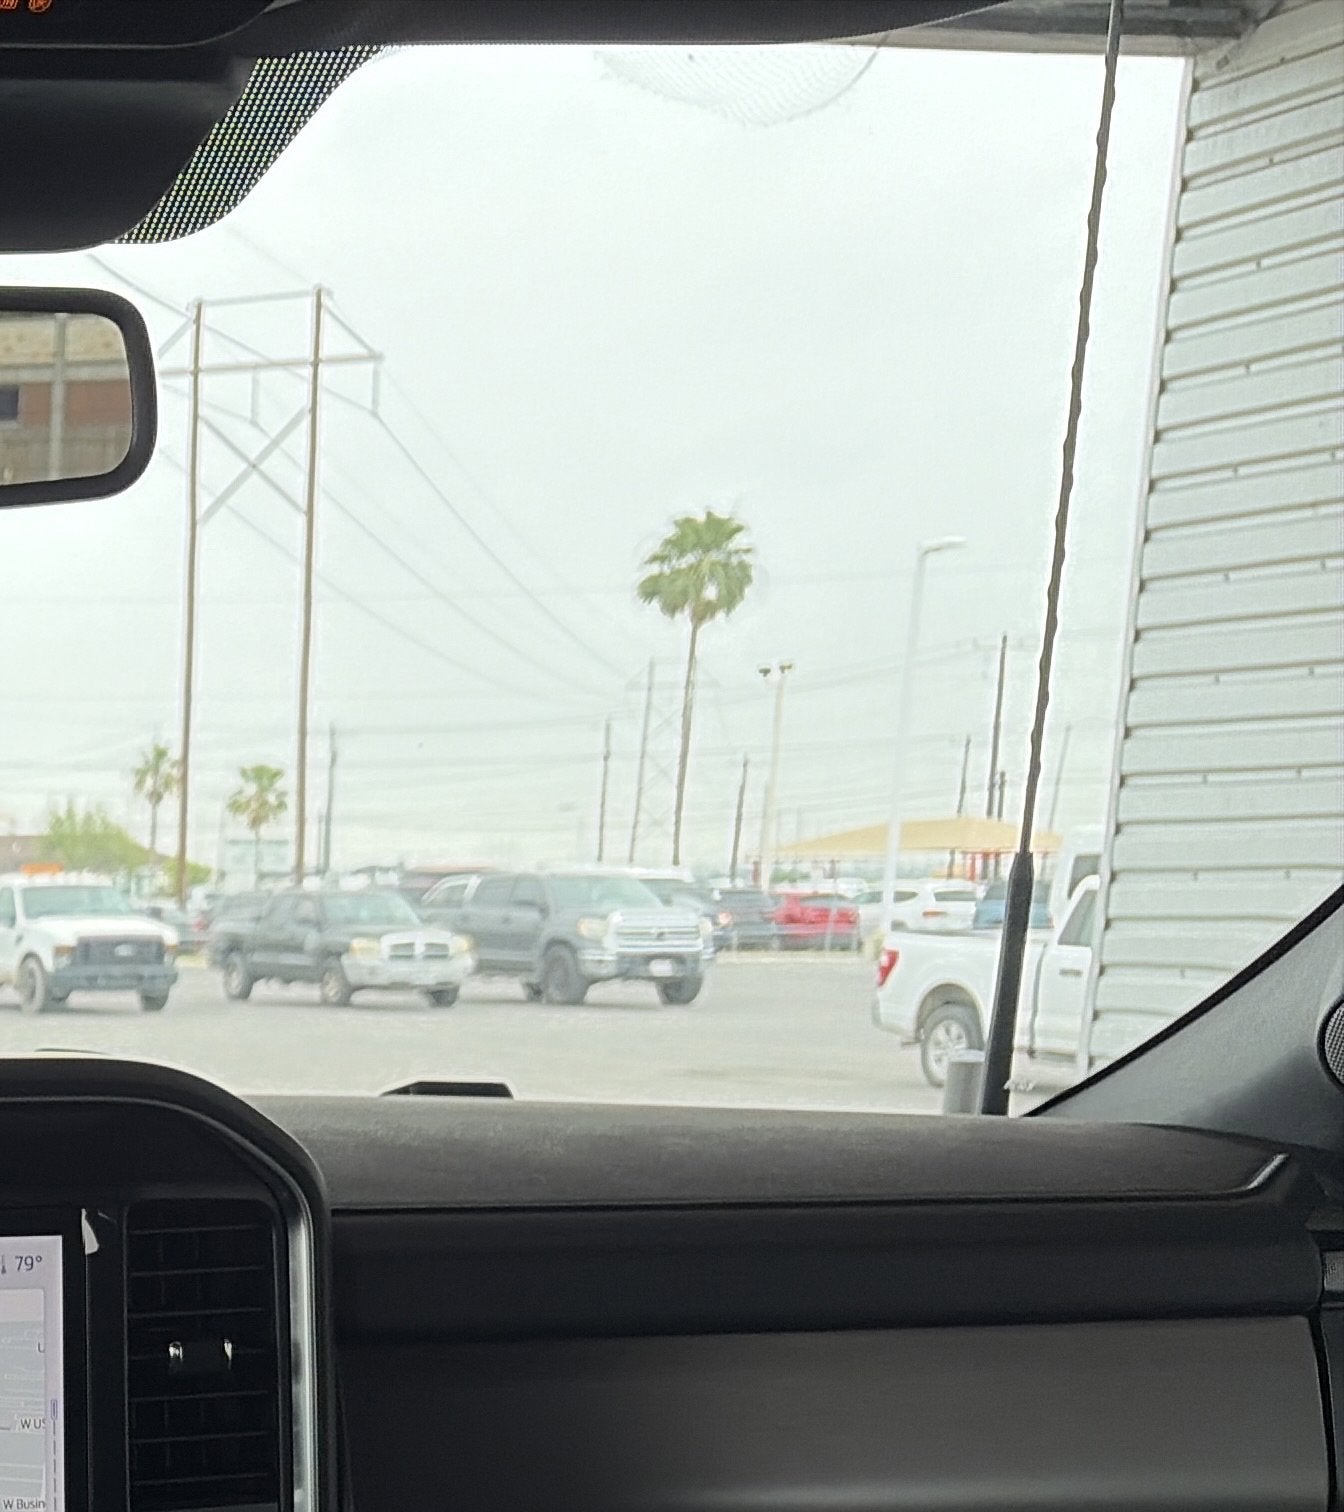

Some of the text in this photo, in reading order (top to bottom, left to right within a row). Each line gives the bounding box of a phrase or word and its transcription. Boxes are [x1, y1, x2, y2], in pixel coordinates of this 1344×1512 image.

[15, 1255, 43, 1272] 79°
[20, 1418, 32, 1430] W
[2, 1499, 14, 1510] W
